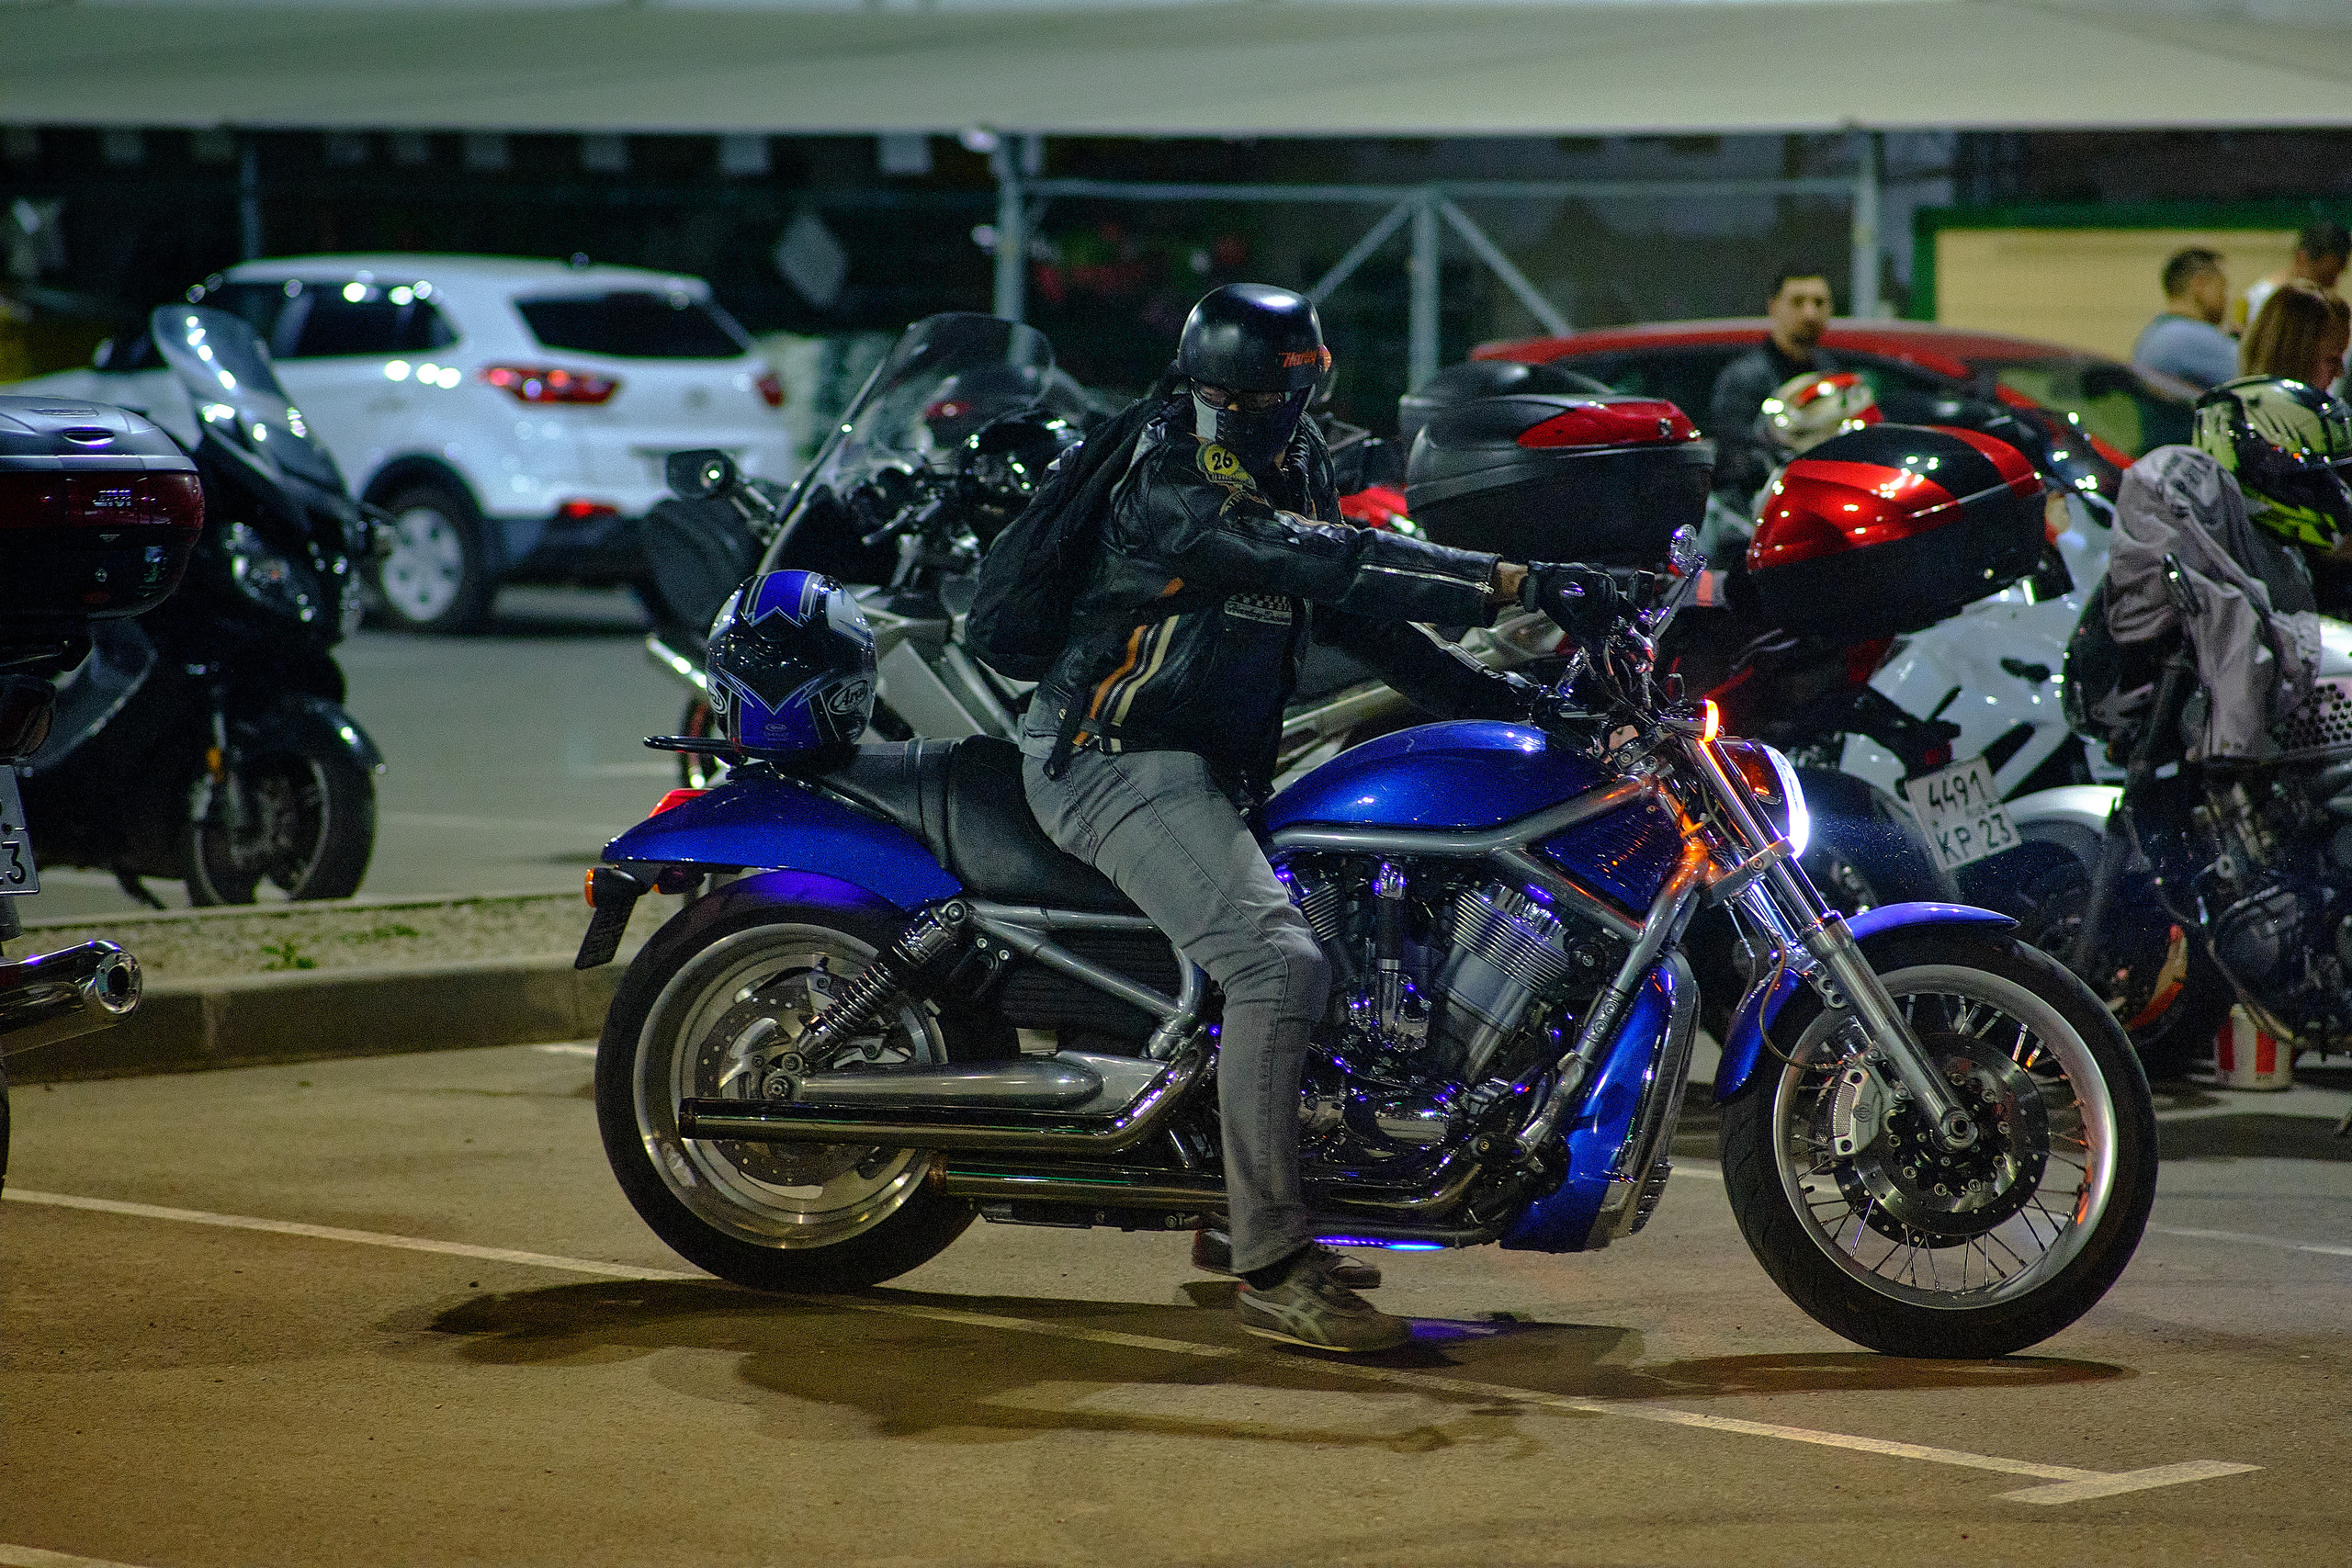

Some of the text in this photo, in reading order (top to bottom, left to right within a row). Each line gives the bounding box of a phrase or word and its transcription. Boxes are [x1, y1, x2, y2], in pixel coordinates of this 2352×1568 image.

[1211, 448, 1234, 471] 26
[1928, 770, 1985, 812] 4491
[1977, 812, 2011, 848] 23
[0, 840, 26, 885] 3
